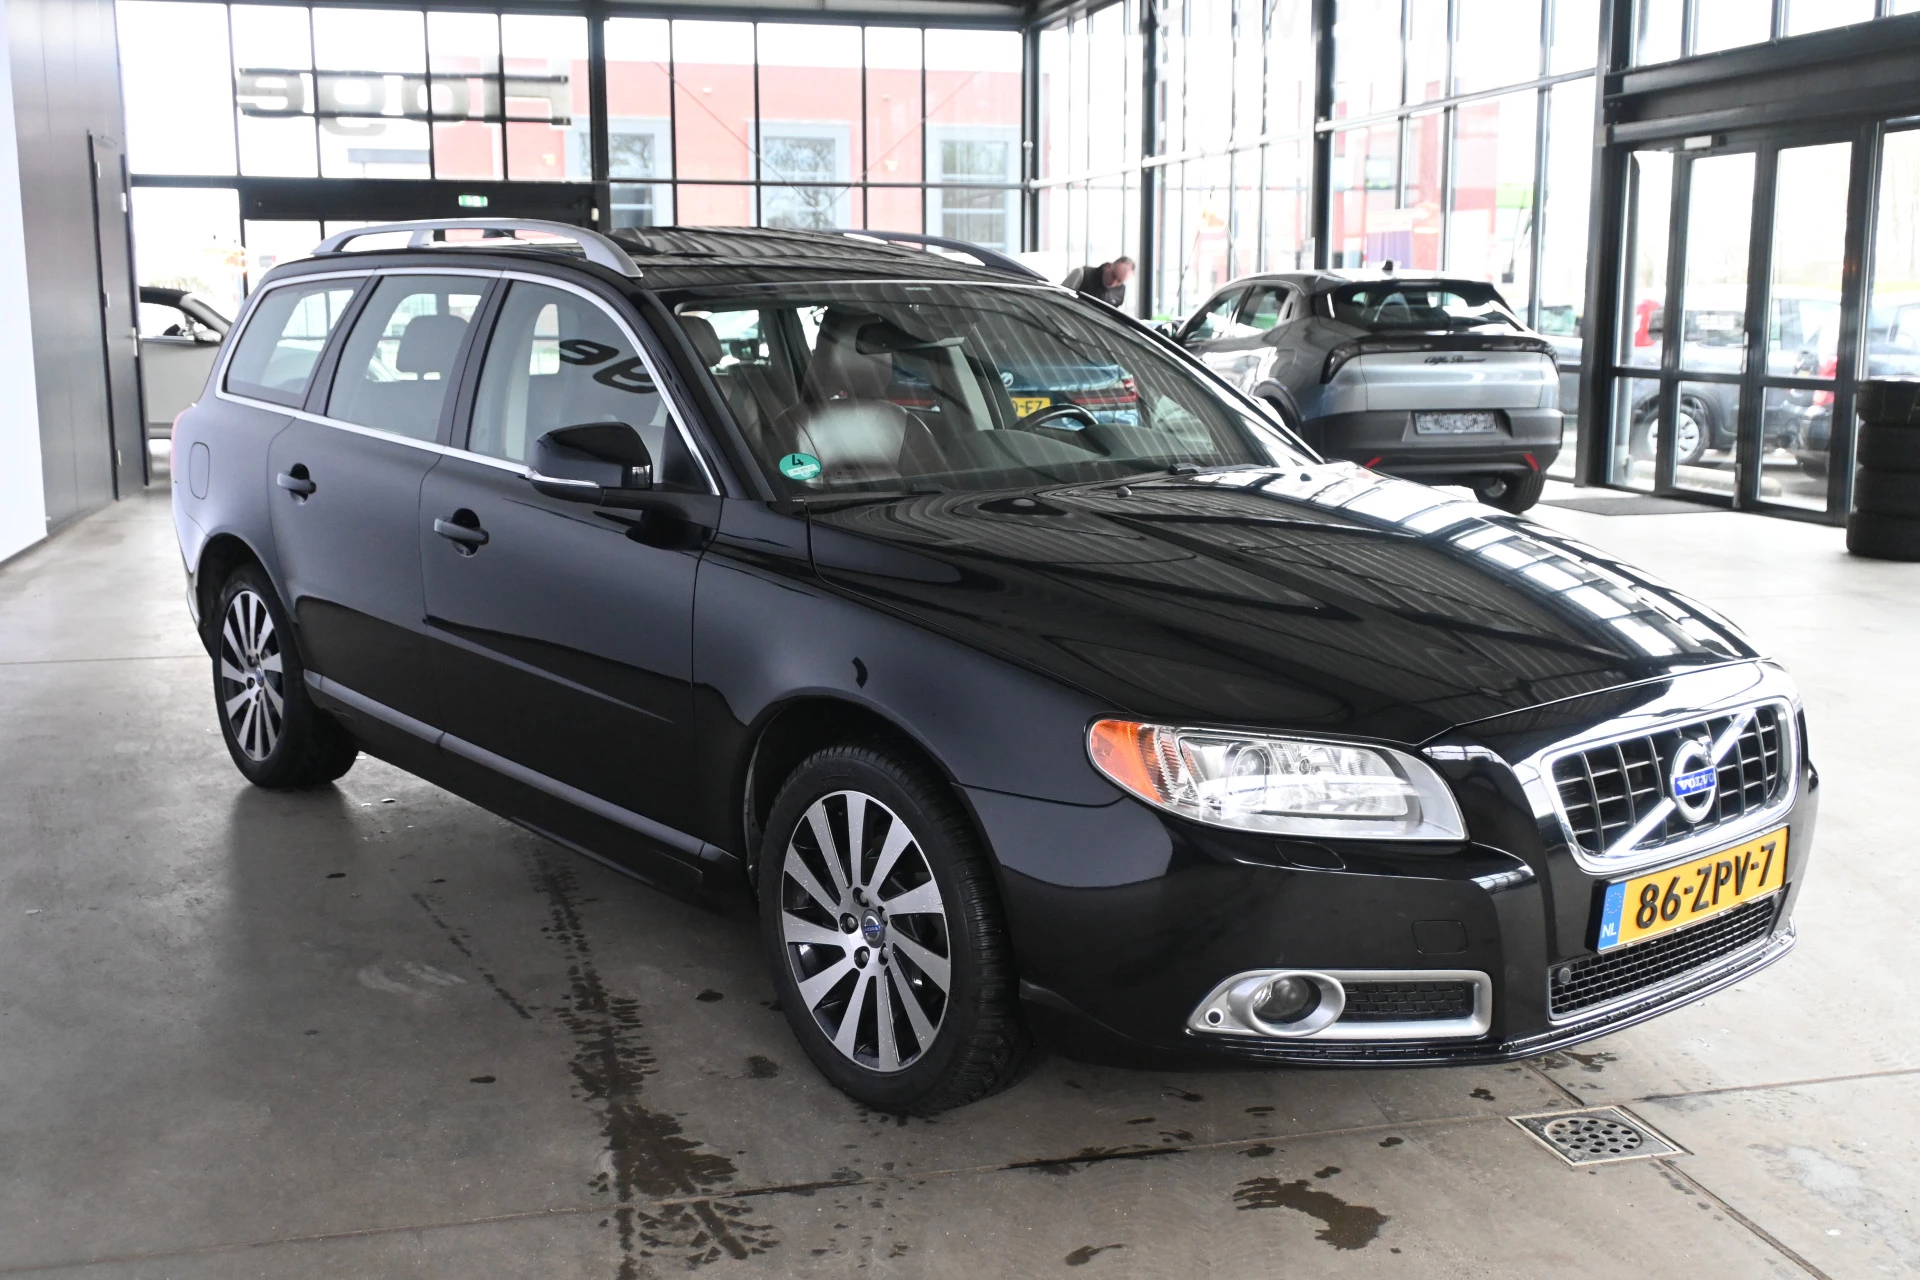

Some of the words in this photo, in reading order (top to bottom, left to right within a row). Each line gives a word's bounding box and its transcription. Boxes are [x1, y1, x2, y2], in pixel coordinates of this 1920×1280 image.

[792, 454, 804, 466] 4
[1676, 772, 1714, 791] VOLVO
[1636, 841, 1777, 930] 86-ZPV-7
[1601, 922, 1617, 938] NL
